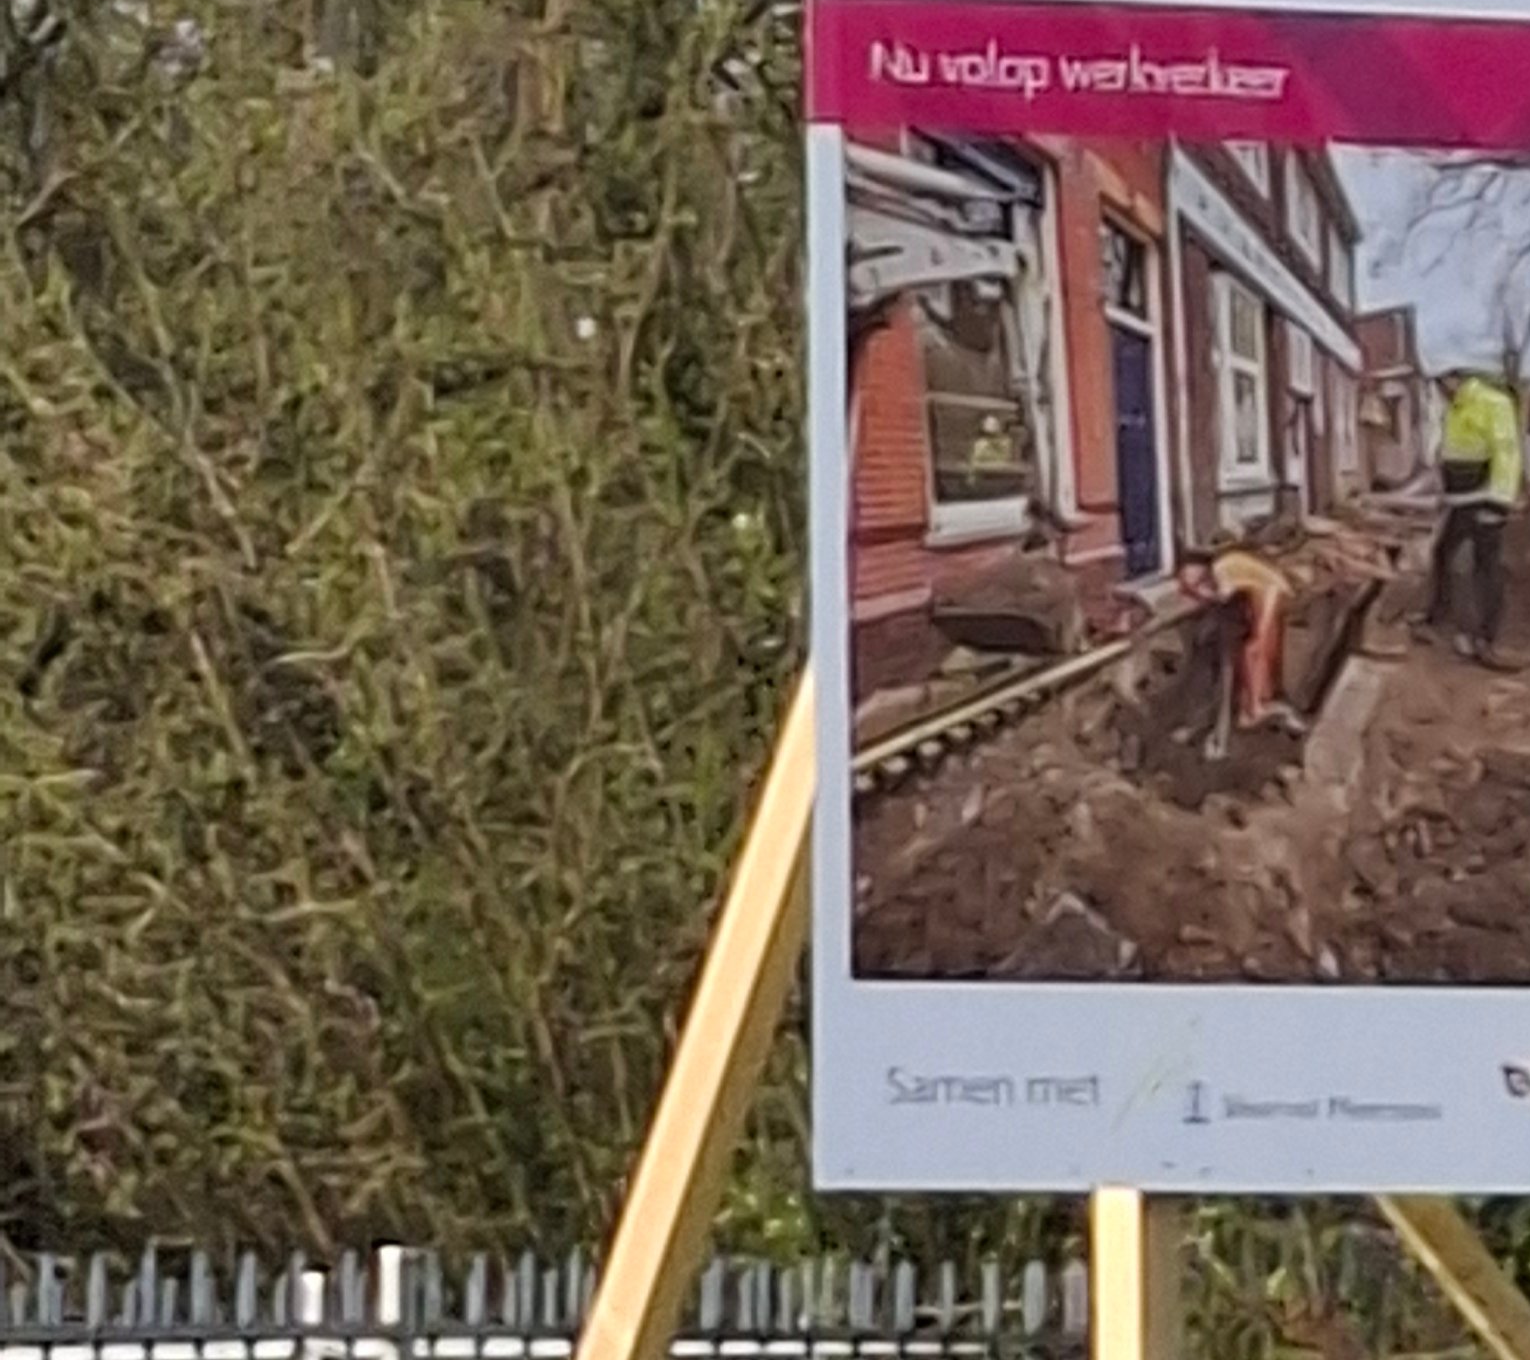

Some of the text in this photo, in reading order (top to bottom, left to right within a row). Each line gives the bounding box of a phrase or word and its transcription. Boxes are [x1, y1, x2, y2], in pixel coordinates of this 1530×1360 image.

[870, 41, 929, 83] Nu
[937, 40, 1050, 100] volop
[887, 1066, 1098, 1106] Samen met
